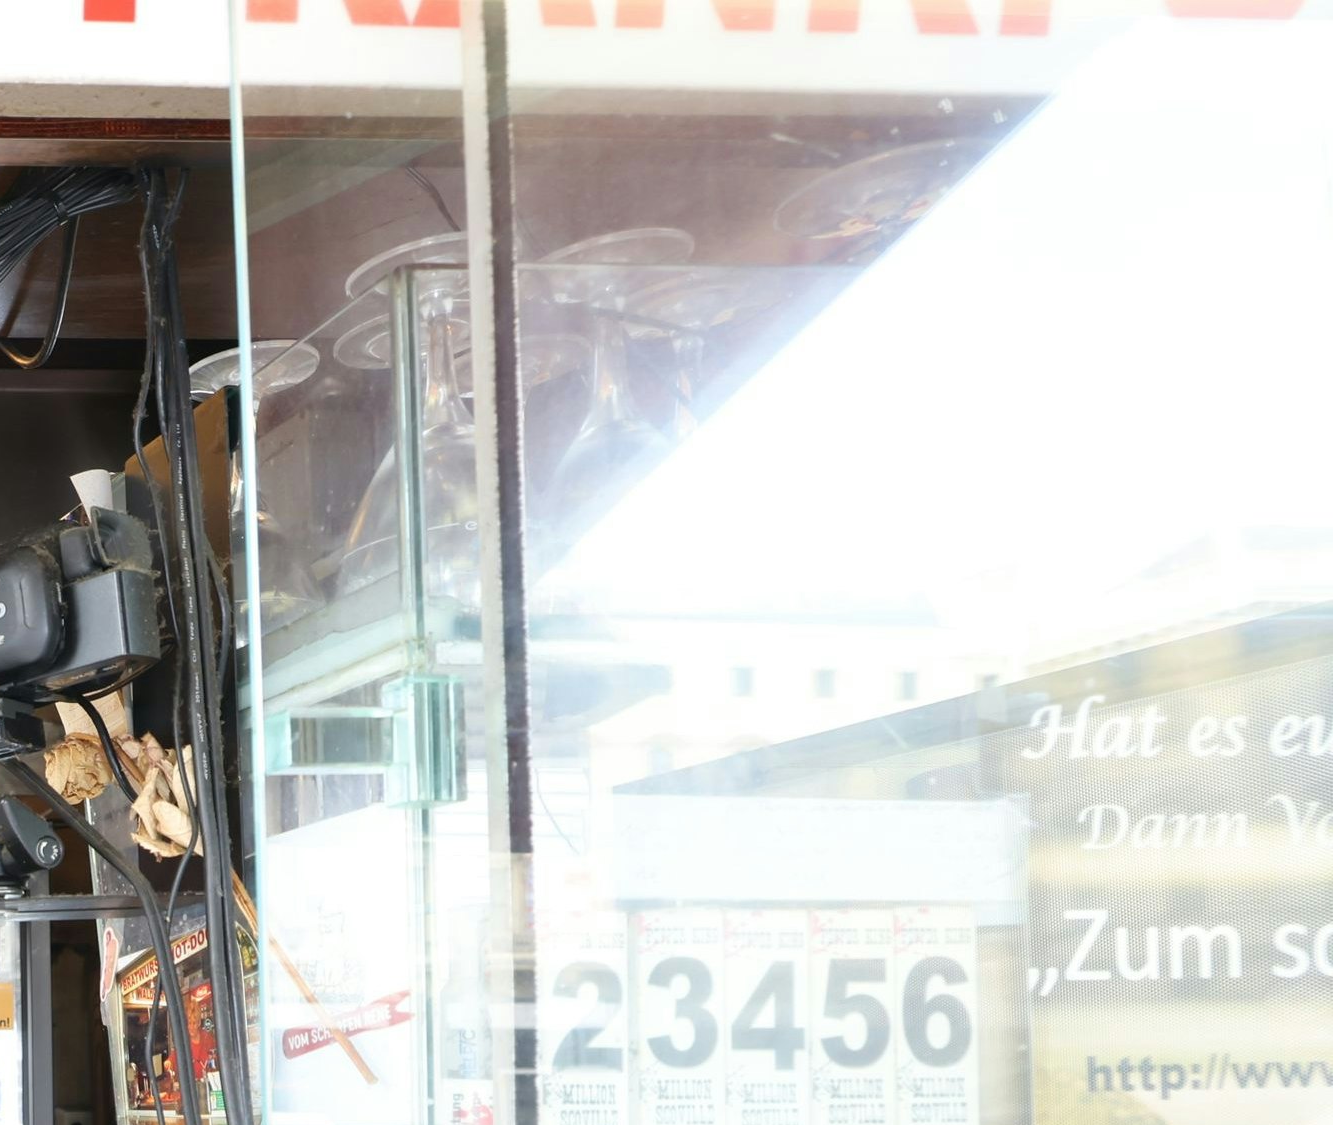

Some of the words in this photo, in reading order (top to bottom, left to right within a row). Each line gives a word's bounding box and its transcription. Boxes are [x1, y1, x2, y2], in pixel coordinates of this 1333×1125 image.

[1021, 695, 1167, 760] Hat
[1189, 714, 1248, 758] es
[1077, 803, 1249, 851] Dann
[172, 928, 209, 958] OT-DO
[1028, 909, 1243, 997] „Zum
[288, 1031, 310, 1050] VOM
[363, 1005, 392, 1026] RENE
[553, 962, 623, 1071] 2
[647, 956, 718, 1068] 3
[731, 960, 804, 1070] 4
[821, 958, 890, 1068] 5
[902, 956, 972, 1068] 6
[562, 1084, 616, 1102] MILLION
[657, 1080, 712, 1100] MILLION
[742, 1083, 797, 1102] MILLION
[829, 1079, 883, 1098] MILLION
[913, 1078, 965, 1098] MILLION
[655, 1106, 715, 1125] SCOVILLE
[828, 1103, 885, 1123] SCOVILLE
[912, 1103, 968, 1123] SCOVILLE
